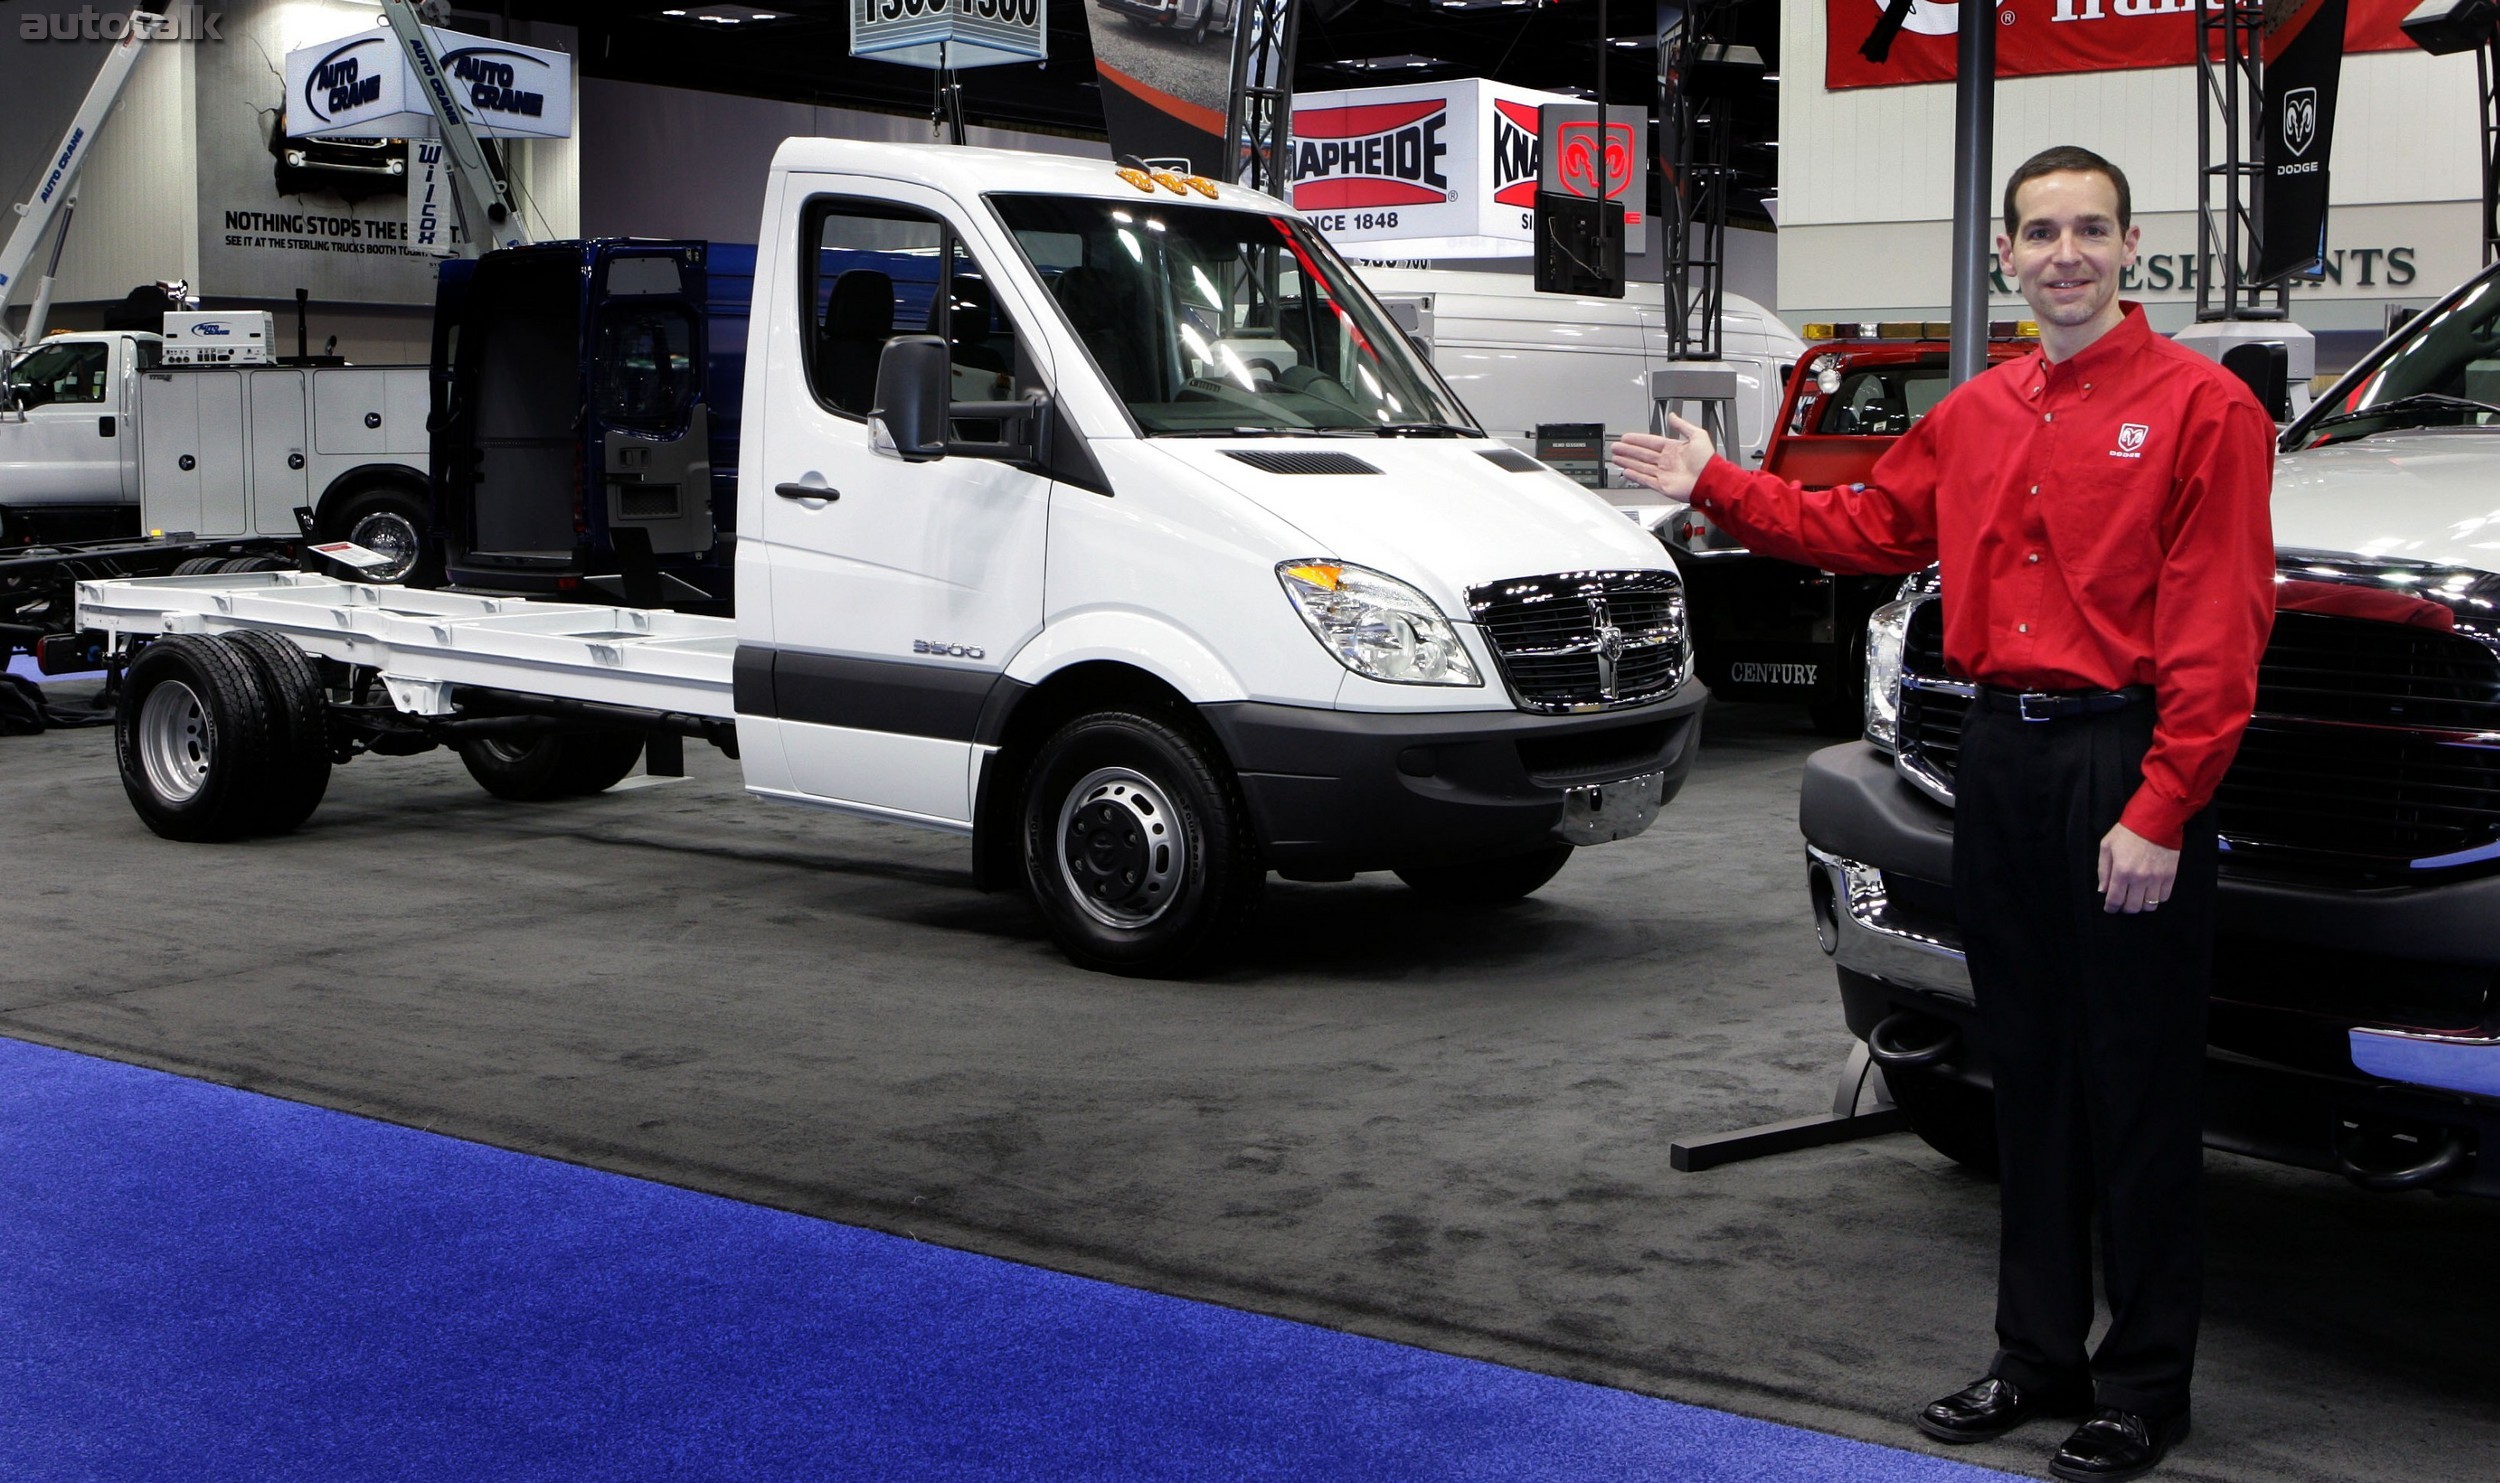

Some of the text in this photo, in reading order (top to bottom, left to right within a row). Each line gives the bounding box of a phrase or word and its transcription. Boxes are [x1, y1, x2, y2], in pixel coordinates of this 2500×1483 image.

[317, 57, 358, 91] AUTO
[410, 39, 435, 76] AUTO
[430, 78, 460, 125] CRANE
[454, 55, 514, 88] AUTO
[329, 74, 381, 114] CRANE
[471, 82, 544, 117] CRANE
[40, 127, 84, 203] AUTO CRANE
[1293, 111, 1447, 190] APHEIDE
[2277, 162, 2318, 175] DODGE
[225, 211, 303, 233] NOTHING
[307, 216, 361, 238] STOPS
[364, 220, 397, 239] THE
[1354, 212, 1398, 230] 1848
[225, 235, 241, 246] SEE
[244, 237, 252, 247] IT
[254, 237, 266, 247] AT
[268, 238, 286, 248] THE
[287, 239, 330, 251] STERLING
[331, 241, 365, 254] TRUCKS
[366, 244, 396, 255] BOOTH
[2109, 450, 2141, 458] DODGE
[913, 639, 985, 659] 3500
